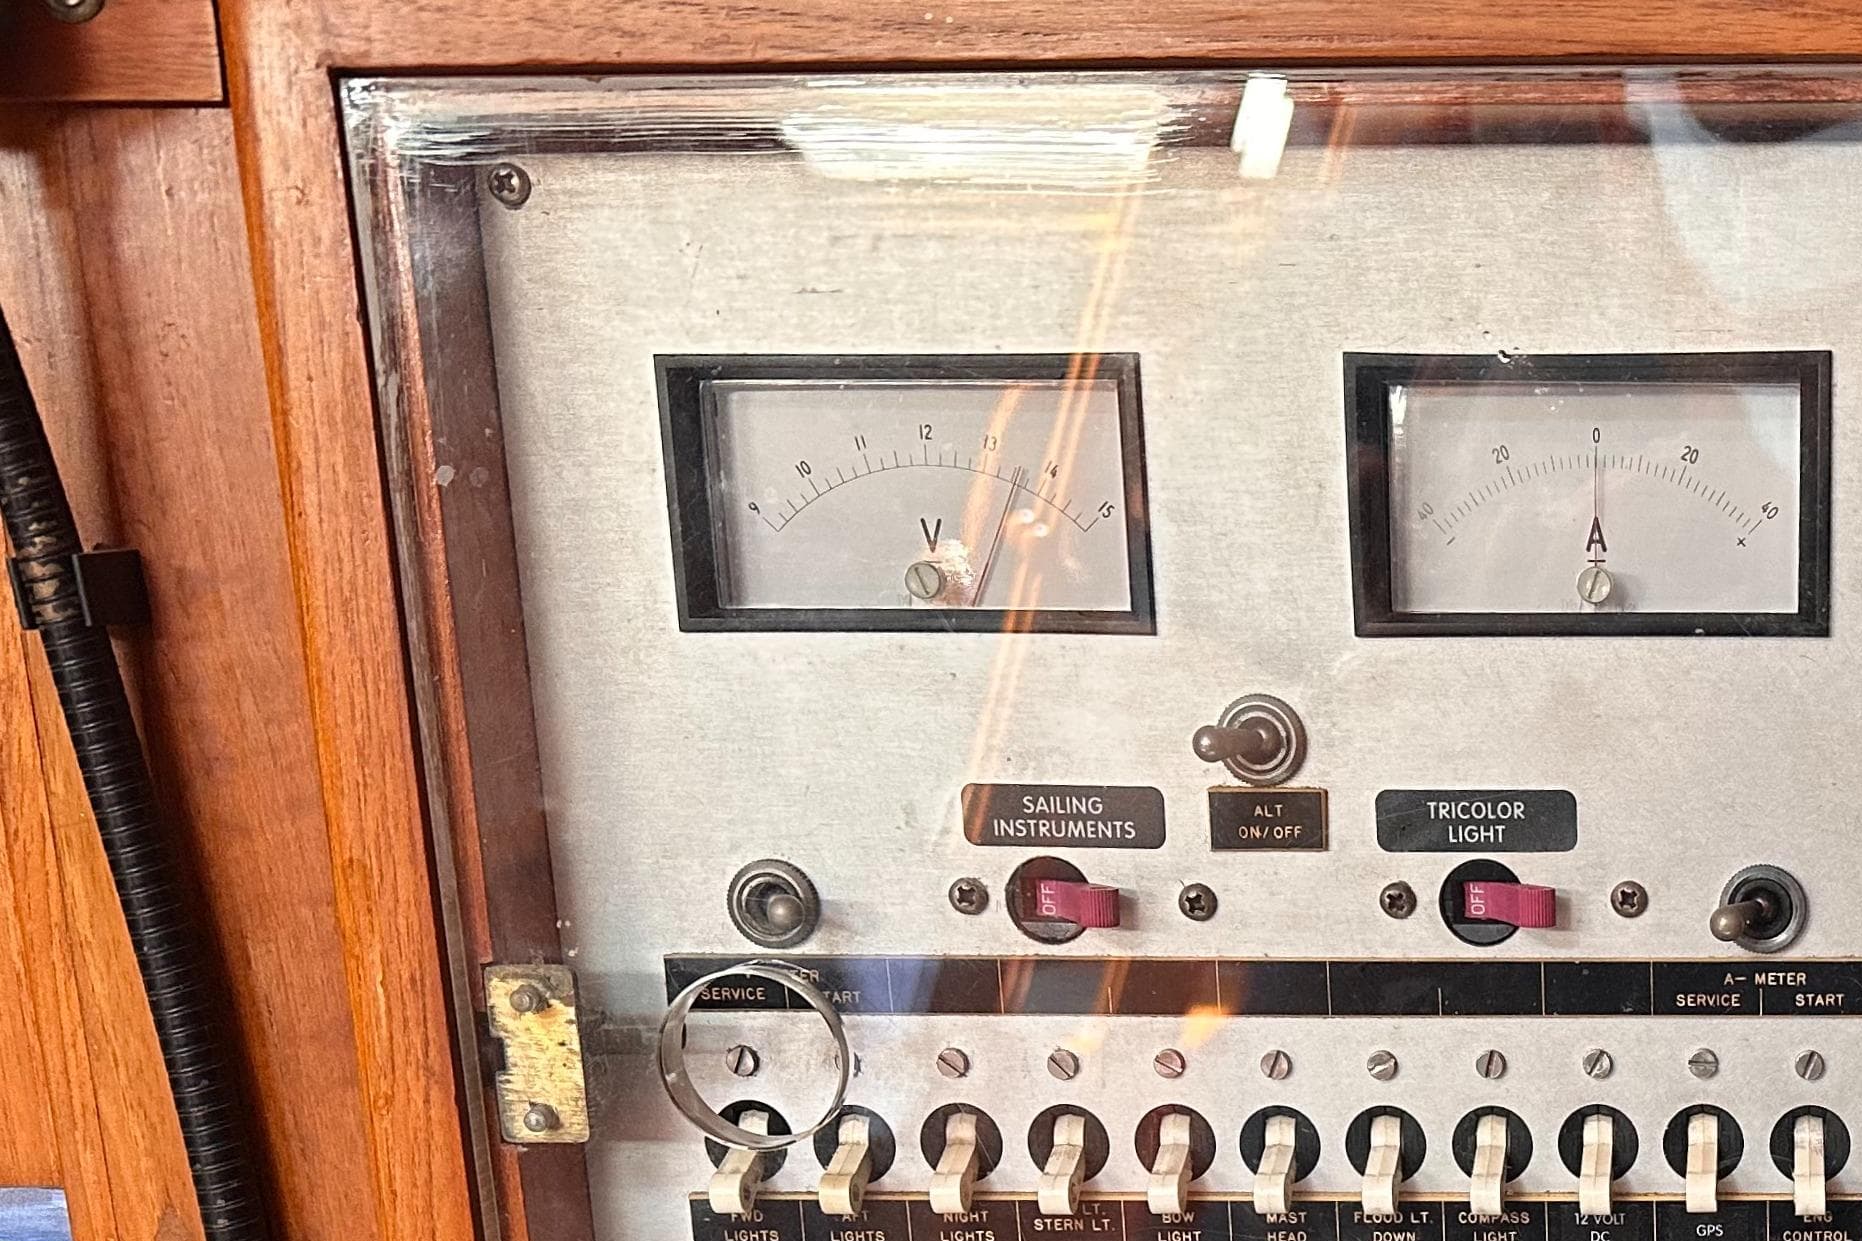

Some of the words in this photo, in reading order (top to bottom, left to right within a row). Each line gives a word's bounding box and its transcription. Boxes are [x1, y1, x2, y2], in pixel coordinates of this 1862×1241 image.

[918, 424, 933, 441] 12
[1592, 427, 1601, 444] 0
[854, 434, 867, 452] 11
[983, 435, 998, 452] 13
[1491, 444, 1510, 465] 20
[1681, 445, 1700, 466] 20
[794, 459, 812, 479] 10
[1044, 460, 1059, 480] 14
[747, 502, 760, 516] 9
[1097, 501, 1116, 520] 15
[1416, 500, 1435, 523] 40
[1760, 501, 1780, 521] 40
[920, 518, 943, 553] V
[1586, 517, 1608, 553] A
[1022, 795, 1103, 815] SAILING
[1254, 804, 1284, 818] ALT
[1427, 800, 1525, 821] TRICOLOR
[993, 819, 1136, 840] INSTRUMENTS
[1447, 824, 1506, 844] LIGHT
[1041, 883, 1056, 916] OFF
[1471, 884, 1486, 915] OFF
[1755, 972, 1807, 987] METER
[701, 987, 765, 1001] SERVICE
[823, 991, 861, 1004] TART
[1675, 993, 1741, 1007] SERVICE
[1794, 993, 1845, 1007] START
[943, 1210, 989, 1223] NIGHT
[1033, 1218, 1084, 1232] STERN
[1091, 1219, 1116, 1232] LT.
[1162, 1211, 1195, 1224] BOW
[1266, 1211, 1307, 1224] MAST
[1354, 1211, 1404, 1224] FLOOD
[1411, 1212, 1433, 1224] LT.
[1458, 1211, 1530, 1224] COMPASS
[1574, 1212, 1589, 1225] 12
[1595, 1212, 1625, 1225] VOLT
[1696, 1224, 1724, 1237] GPS
